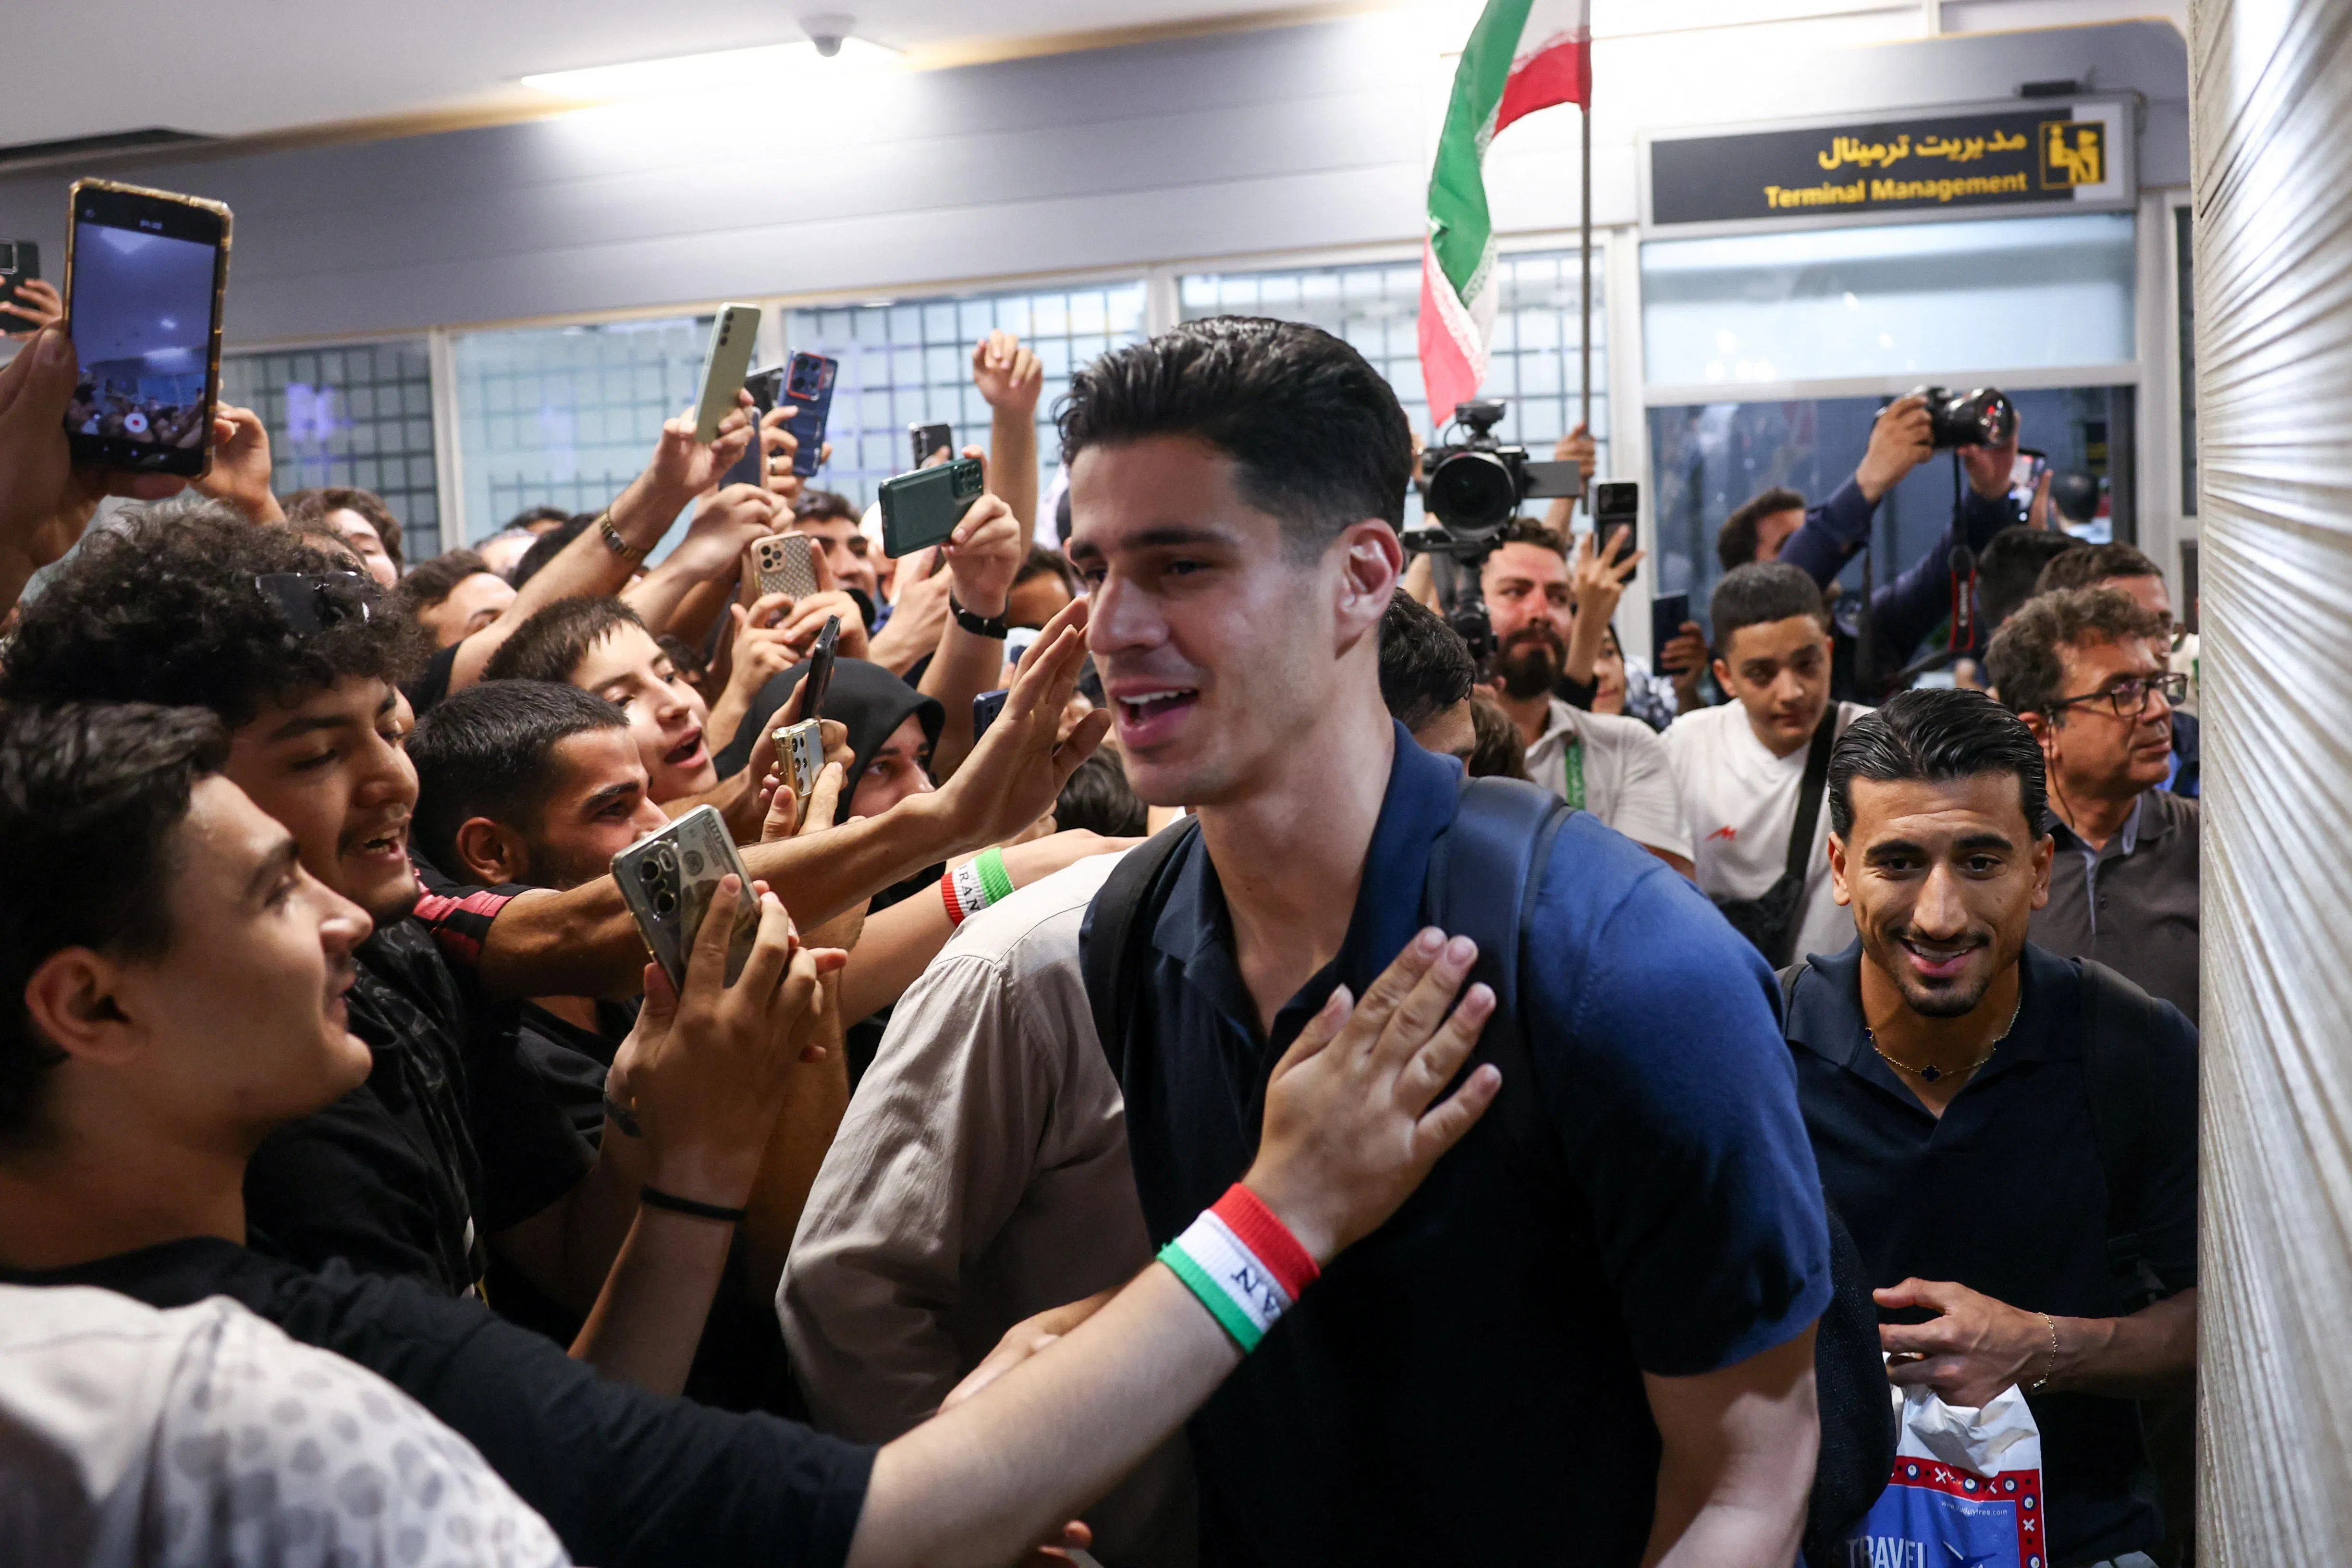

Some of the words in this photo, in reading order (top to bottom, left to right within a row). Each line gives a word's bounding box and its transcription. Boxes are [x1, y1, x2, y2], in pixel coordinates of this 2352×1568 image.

[1818, 134, 1910, 170] ترمینال
[1914, 130, 2028, 162] مدیریت
[1764, 179, 1867, 208] Terminal
[1871, 171, 2028, 202] Management
[959, 865, 981, 911] IRAN
